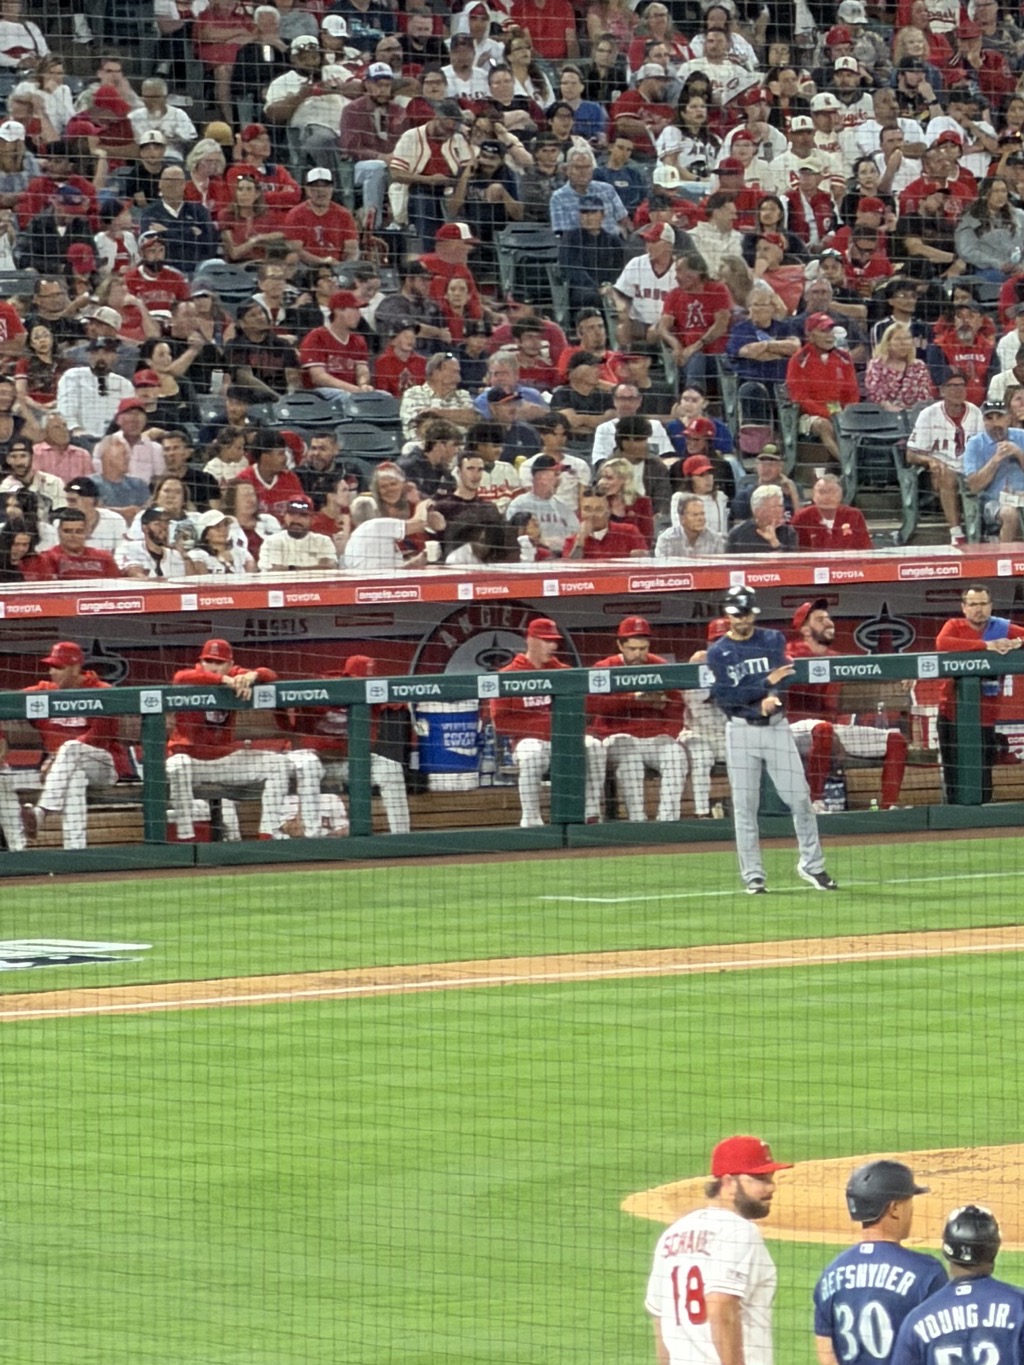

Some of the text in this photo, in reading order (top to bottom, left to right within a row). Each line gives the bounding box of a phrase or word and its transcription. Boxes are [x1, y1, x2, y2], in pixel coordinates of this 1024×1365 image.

[831, 570, 864, 579] TOYOTA
[901, 565, 959, 576] angels.com
[632, 577, 690, 589] angels.com
[747, 573, 781, 582] TOYOTA
[475, 586, 509, 595] TOYOTA
[560, 582, 594, 591] TOYOTA
[286, 593, 320, 602] TOYOTA
[359, 588, 418, 600] angels.com
[80, 599, 141, 612] angels.com
[200, 596, 234, 606] TOYOTA
[7, 604, 42, 613] TOYOTA
[834, 664, 882, 676] TOYOTA
[942, 659, 990, 671] TOYOTA
[503, 679, 552, 691] TOYOTA
[613, 674, 663, 686] TOYOTA
[279, 689, 329, 701] TOYOTA
[391, 684, 441, 696] TOYOTA
[52, 699, 103, 711] TOYOTA
[166, 694, 217, 706] TOYOTA
[821, 1263, 916, 1301] REFSNYDER
[671, 1265, 707, 1326] 18
[914, 1302, 1015, 1343] YOUNG JR.
[834, 1301, 894, 1361] 30
